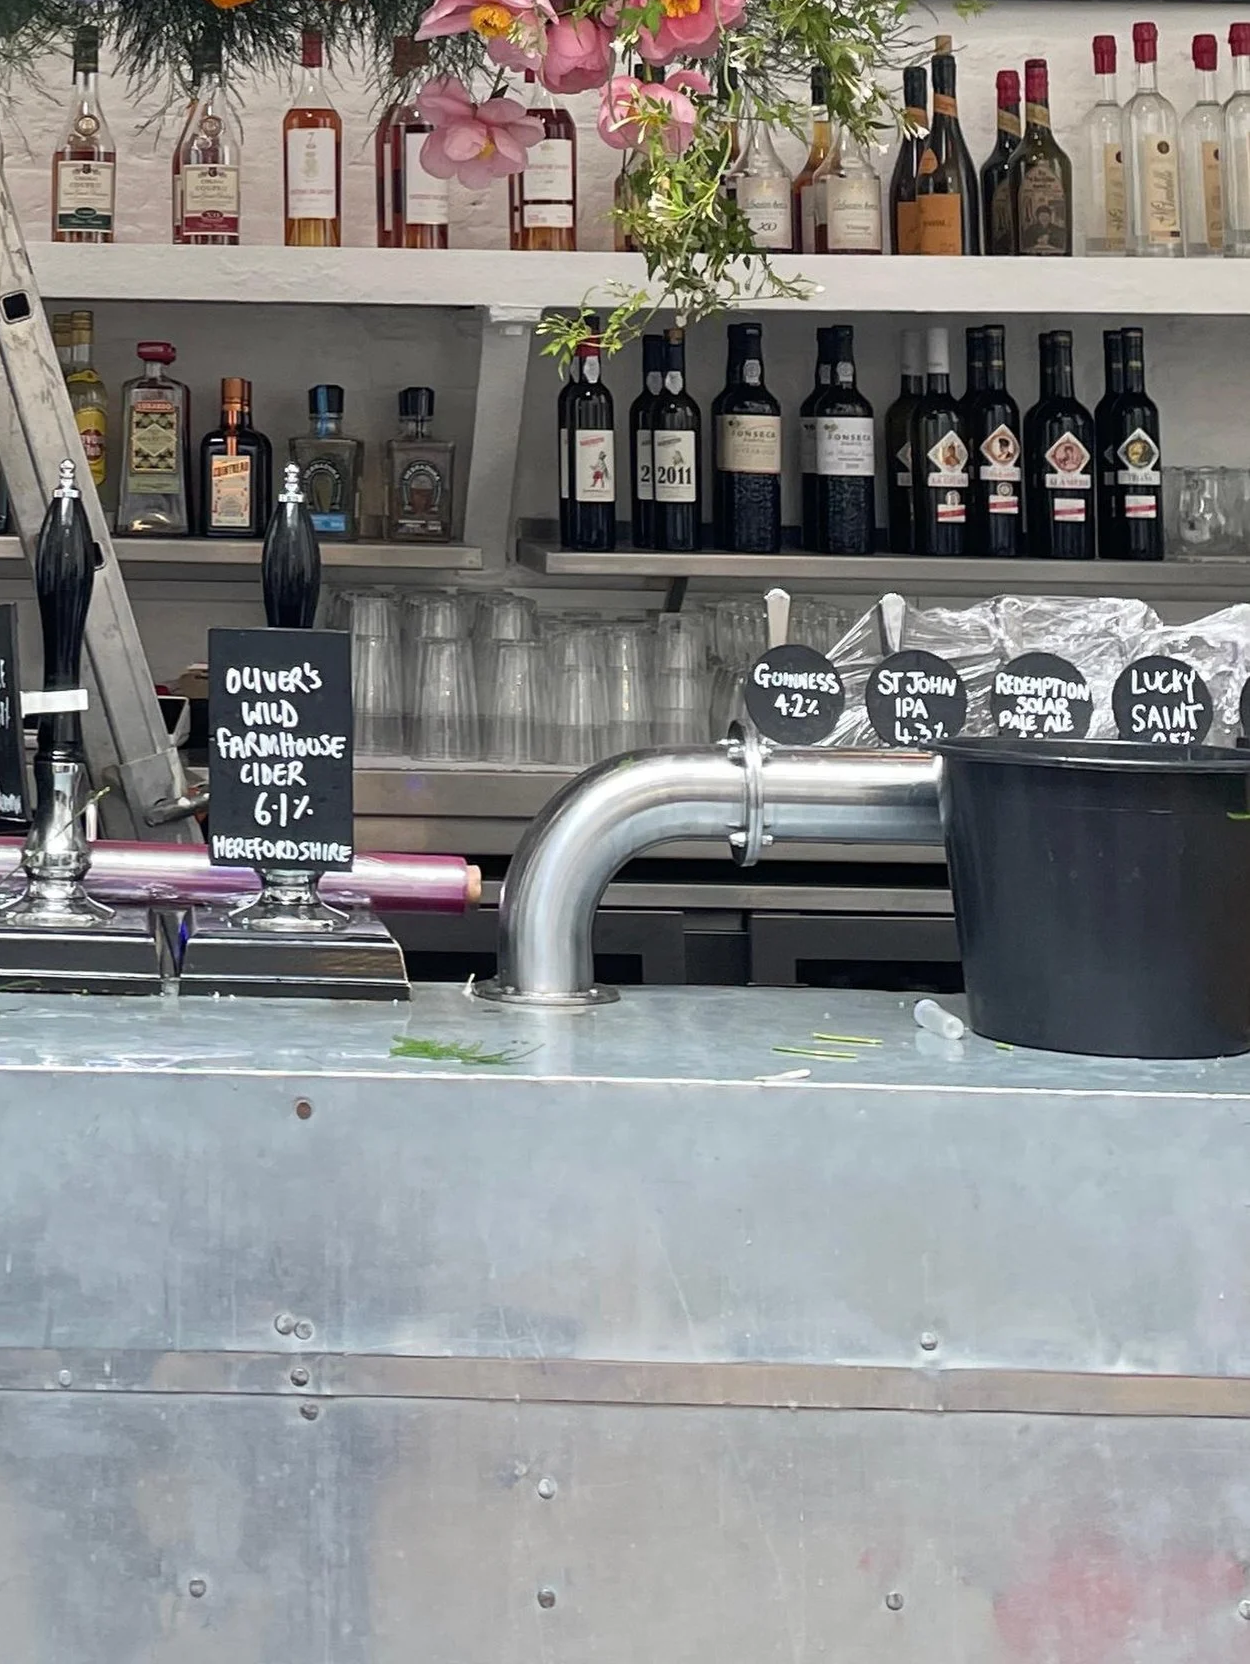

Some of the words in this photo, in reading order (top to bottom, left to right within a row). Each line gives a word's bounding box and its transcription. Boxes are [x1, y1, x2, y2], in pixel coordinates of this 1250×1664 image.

[731, 429, 776, 439] FONSECA
[657, 465, 693, 485] 2011
[224, 661, 323, 695] OLIVER'S
[753, 662, 841, 695] GUINNESS
[877, 669, 904, 696] ST
[905, 671, 958, 697] JOHN
[995, 671, 1090, 702] REDEMPTION
[1131, 668, 1196, 704] LUCKY
[240, 698, 300, 729] WILD
[774, 692, 820, 718] 4.2%
[895, 697, 929, 720] IPA
[1015, 695, 1069, 716] SOLAR
[1131, 701, 1205, 734] SAINT
[895, 720, 949, 745] 4.3%
[999, 709, 1038, 732] PALE
[1043, 711, 1075, 734] ALE
[215, 727, 347, 761] FARMHOUSE
[239, 761, 307, 787] CIDER
[253, 791, 315, 828] 6.1%
[211, 834, 353, 865] HEREFORDSHIRE
